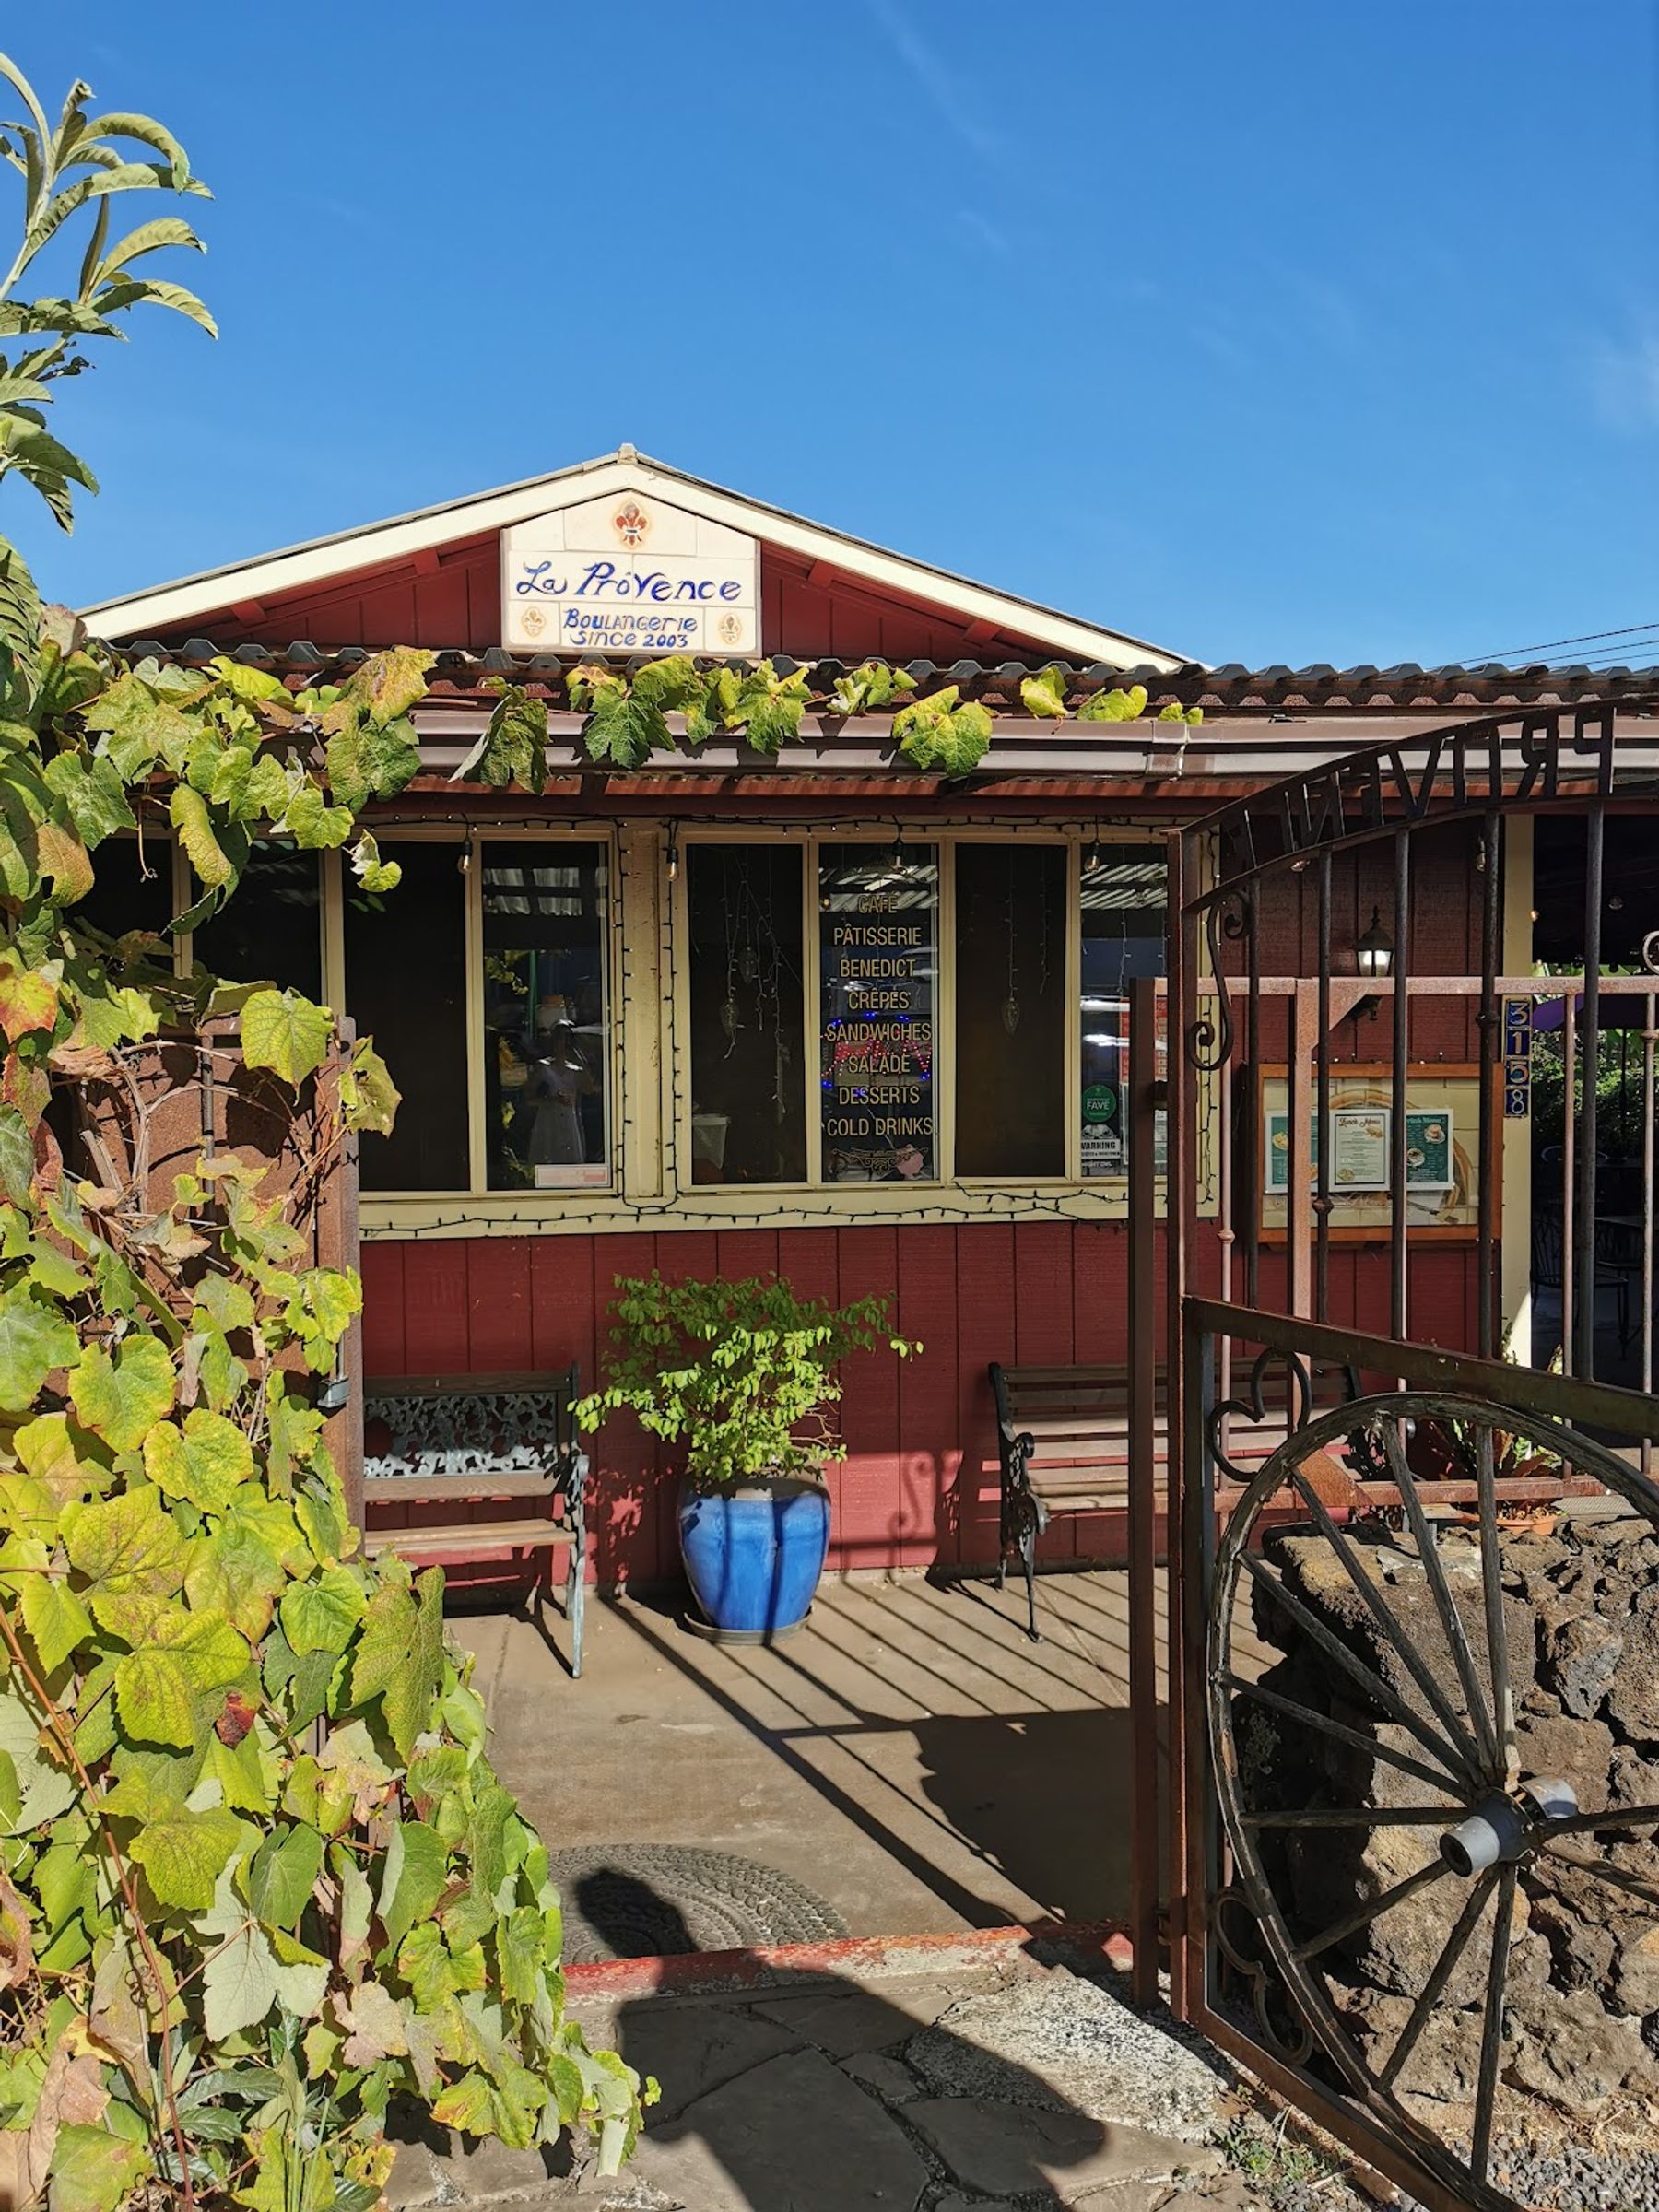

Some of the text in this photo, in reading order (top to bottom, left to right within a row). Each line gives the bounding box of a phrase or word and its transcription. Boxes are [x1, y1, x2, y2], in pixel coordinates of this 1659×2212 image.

[516, 560, 568, 595] La
[642, 633, 689, 648] 2003
[833, 923, 922, 946] PÂTISSERIE
[840, 959, 916, 978] BENEDICT
[826, 1022, 932, 1041] SANDWICHES
[1509, 1002, 1530, 1115] 3158
[839, 1086, 921, 1105] DESSERTS
[1087, 1101, 1110, 1111] FAVE
[827, 1116, 933, 1136] COLD DRINKS
